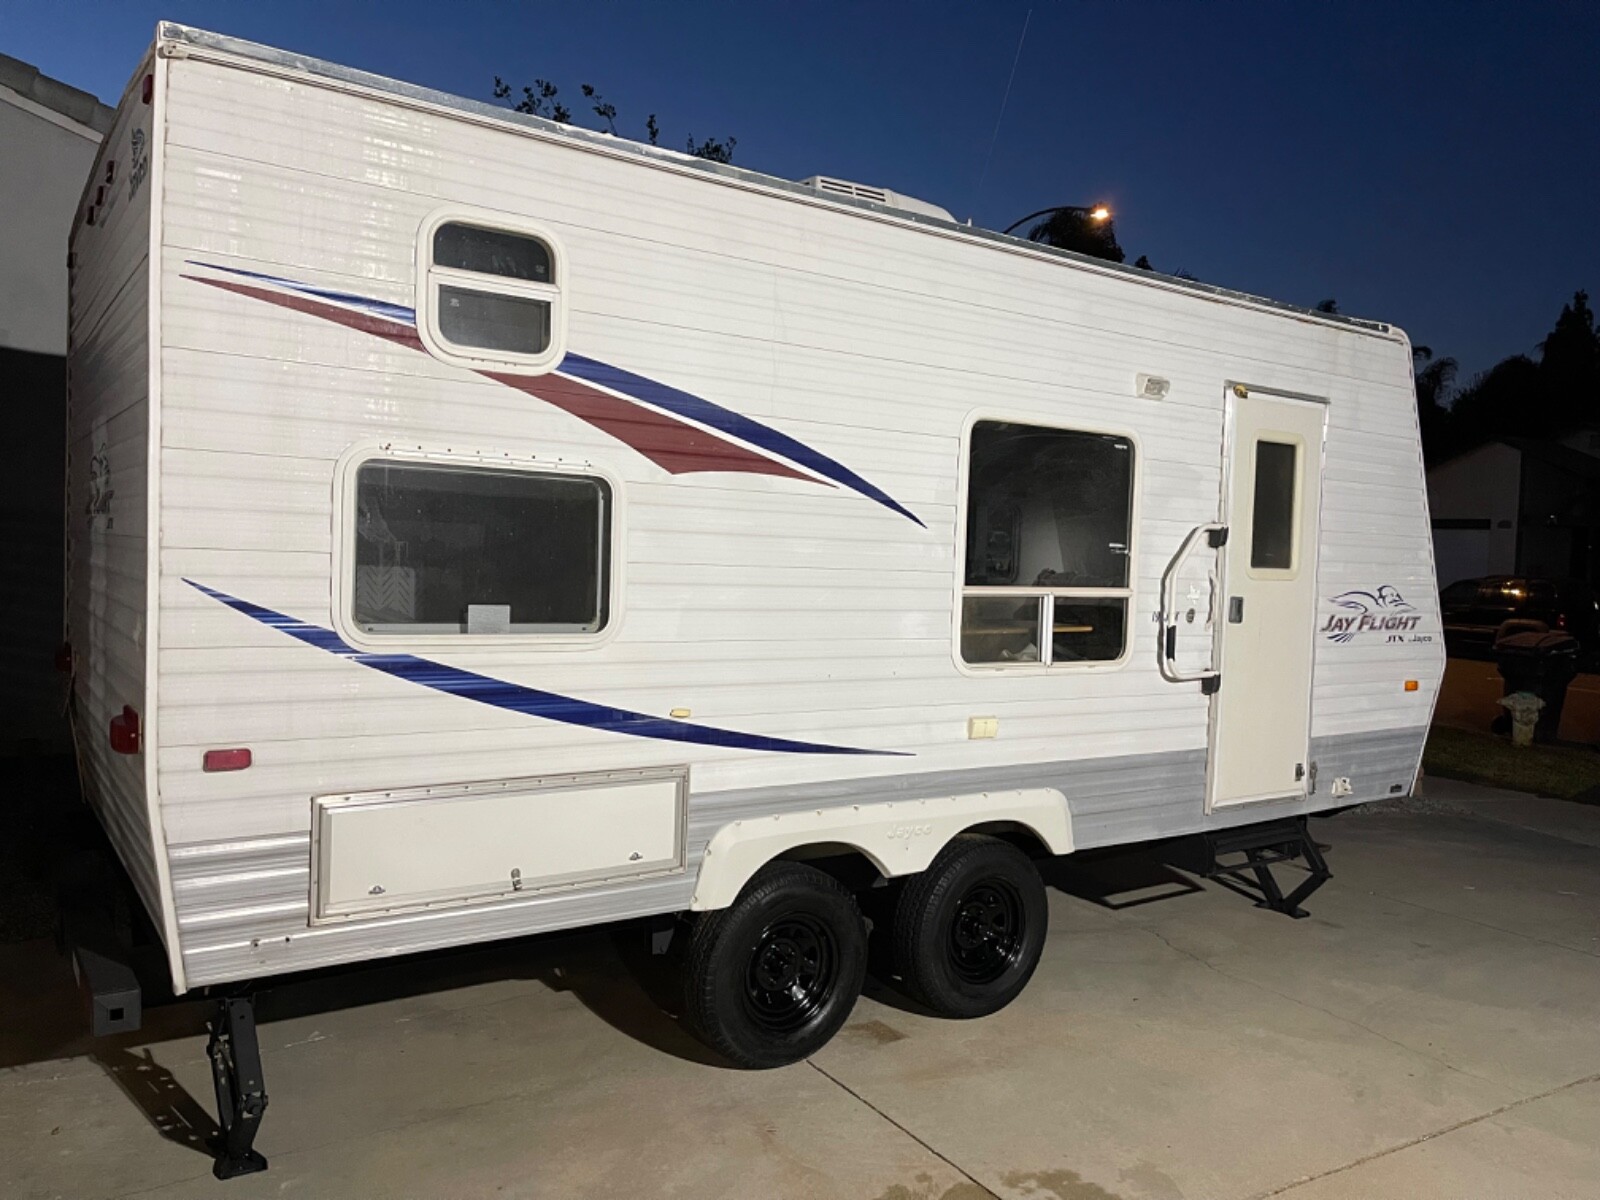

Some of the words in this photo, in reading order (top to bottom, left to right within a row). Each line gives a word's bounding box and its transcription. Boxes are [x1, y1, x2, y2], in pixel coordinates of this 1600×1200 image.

[1320, 614, 1356, 632] JAY
[1357, 615, 1421, 631] FLIGHT
[886, 823, 932, 840] Jayco
